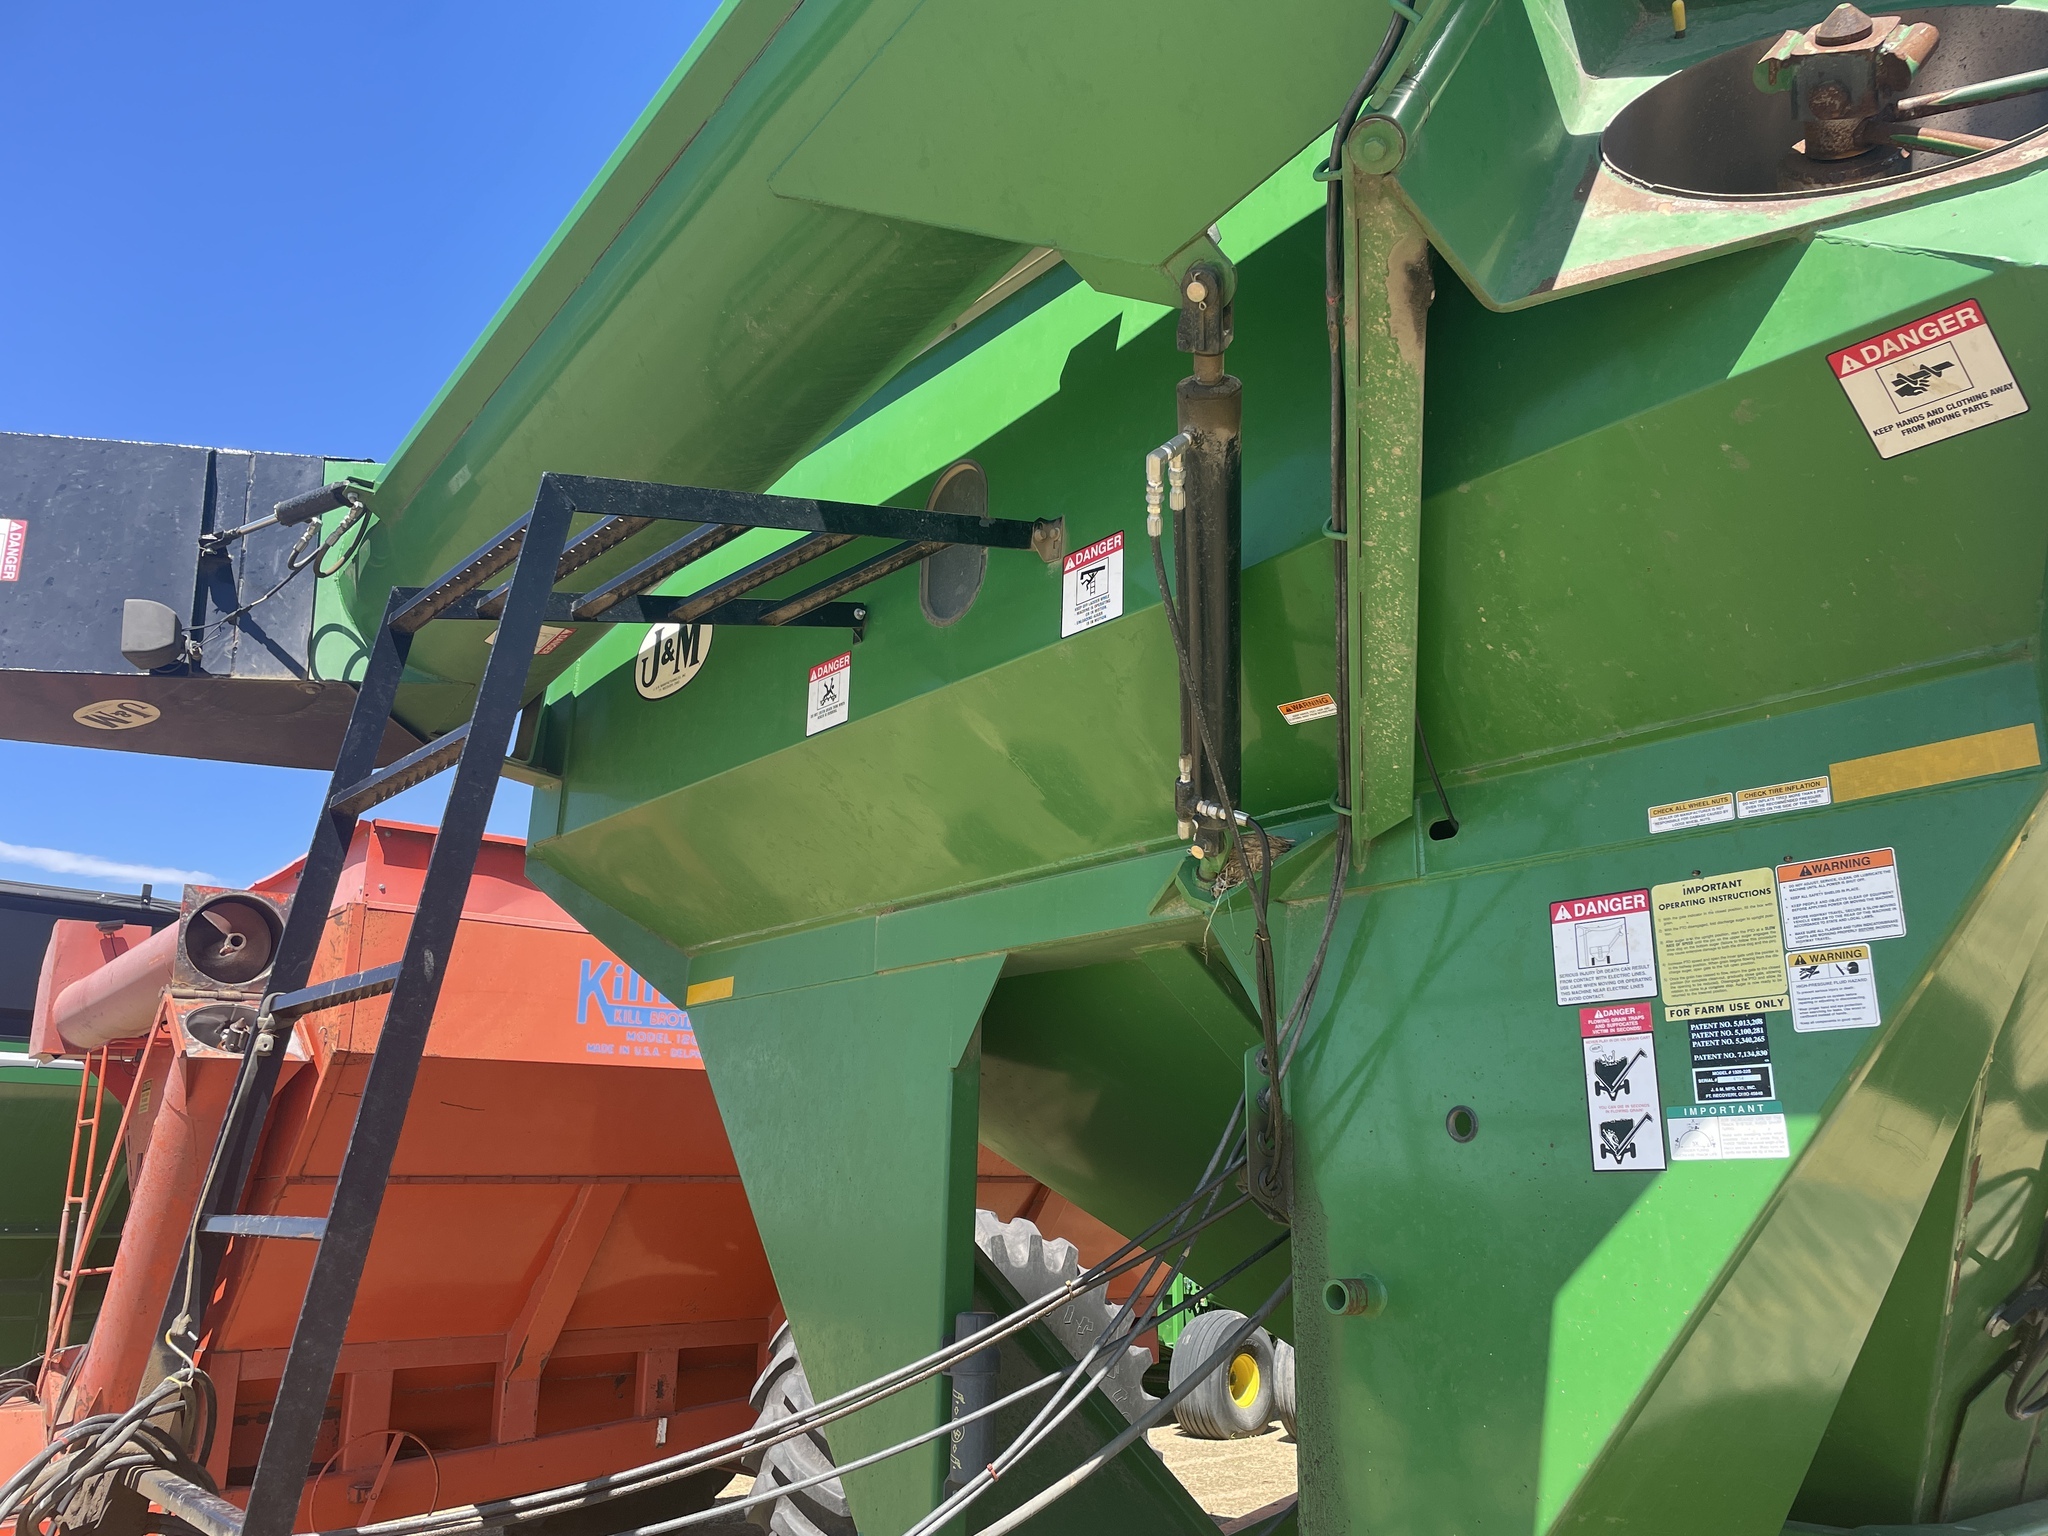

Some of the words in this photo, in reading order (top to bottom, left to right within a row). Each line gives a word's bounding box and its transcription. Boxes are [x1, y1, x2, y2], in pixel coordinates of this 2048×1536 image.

[1860, 307, 1980, 364] DANGER
[1872, 424, 1894, 437] KEEP
[1895, 413, 1925, 429] HANDS
[1925, 406, 1944, 418] AND
[1945, 390, 1988, 411] CLOTHING
[1988, 381, 2015, 396] AWAY
[1900, 422, 1926, 436] FROM
[1926, 410, 1961, 427] MOVING
[1961, 399, 1993, 415] PARTS.
[2, 532, 22, 579] DANGER
[1075, 533, 1121, 565] DANGER
[642, 624, 700, 688] J&M
[817, 655, 849, 677] DANGER
[1291, 698, 1328, 711] WARNING
[80, 703, 153, 728] J&M
[1743, 790, 1766, 799] CHECK
[1784, 780, 1820, 792] INFLATION
[1652, 806, 1673, 815] CHECK
[1688, 800, 1710, 808] WHEEL
[1711, 796, 1728, 804] NUTS
[1812, 857, 1870, 873] WARNING
[1682, 879, 1742, 895] IMPORTANT
[1574, 894, 1646, 917] DANGER
[1658, 896, 1705, 911] OPERATING
[1708, 887, 1771, 903] INSTRUCTIONS
[1809, 949, 1862, 962] WARNING
[1625, 975, 1652, 983] OPERATING
[1602, 1007, 1635, 1017] DANGER
[1670, 1008, 1690, 1018] FOR
[1695, 1004, 1725, 1015] FARM
[1729, 1002, 1750, 1011] USE
[1755, 998, 1784, 1009] ONLY
[614, 1009, 642, 1025] KILL
[1690, 1022, 1718, 1031] PATENT
[1719, 1020, 1732, 1028] NO.
[626, 1031, 672, 1044] MODEL
[1691, 1030, 1719, 1039] PATENT
[1692, 1039, 1720, 1047] PATENT
[1721, 1037, 1734, 1045] NO.
[586, 1043, 614, 1055] MADE
[619, 1045, 630, 1055] IN
[1693, 1052, 1722, 1061] PATENT
[1723, 1051, 1736, 1059] NO.
[1684, 1104, 1764, 1116] IMPORTANT
